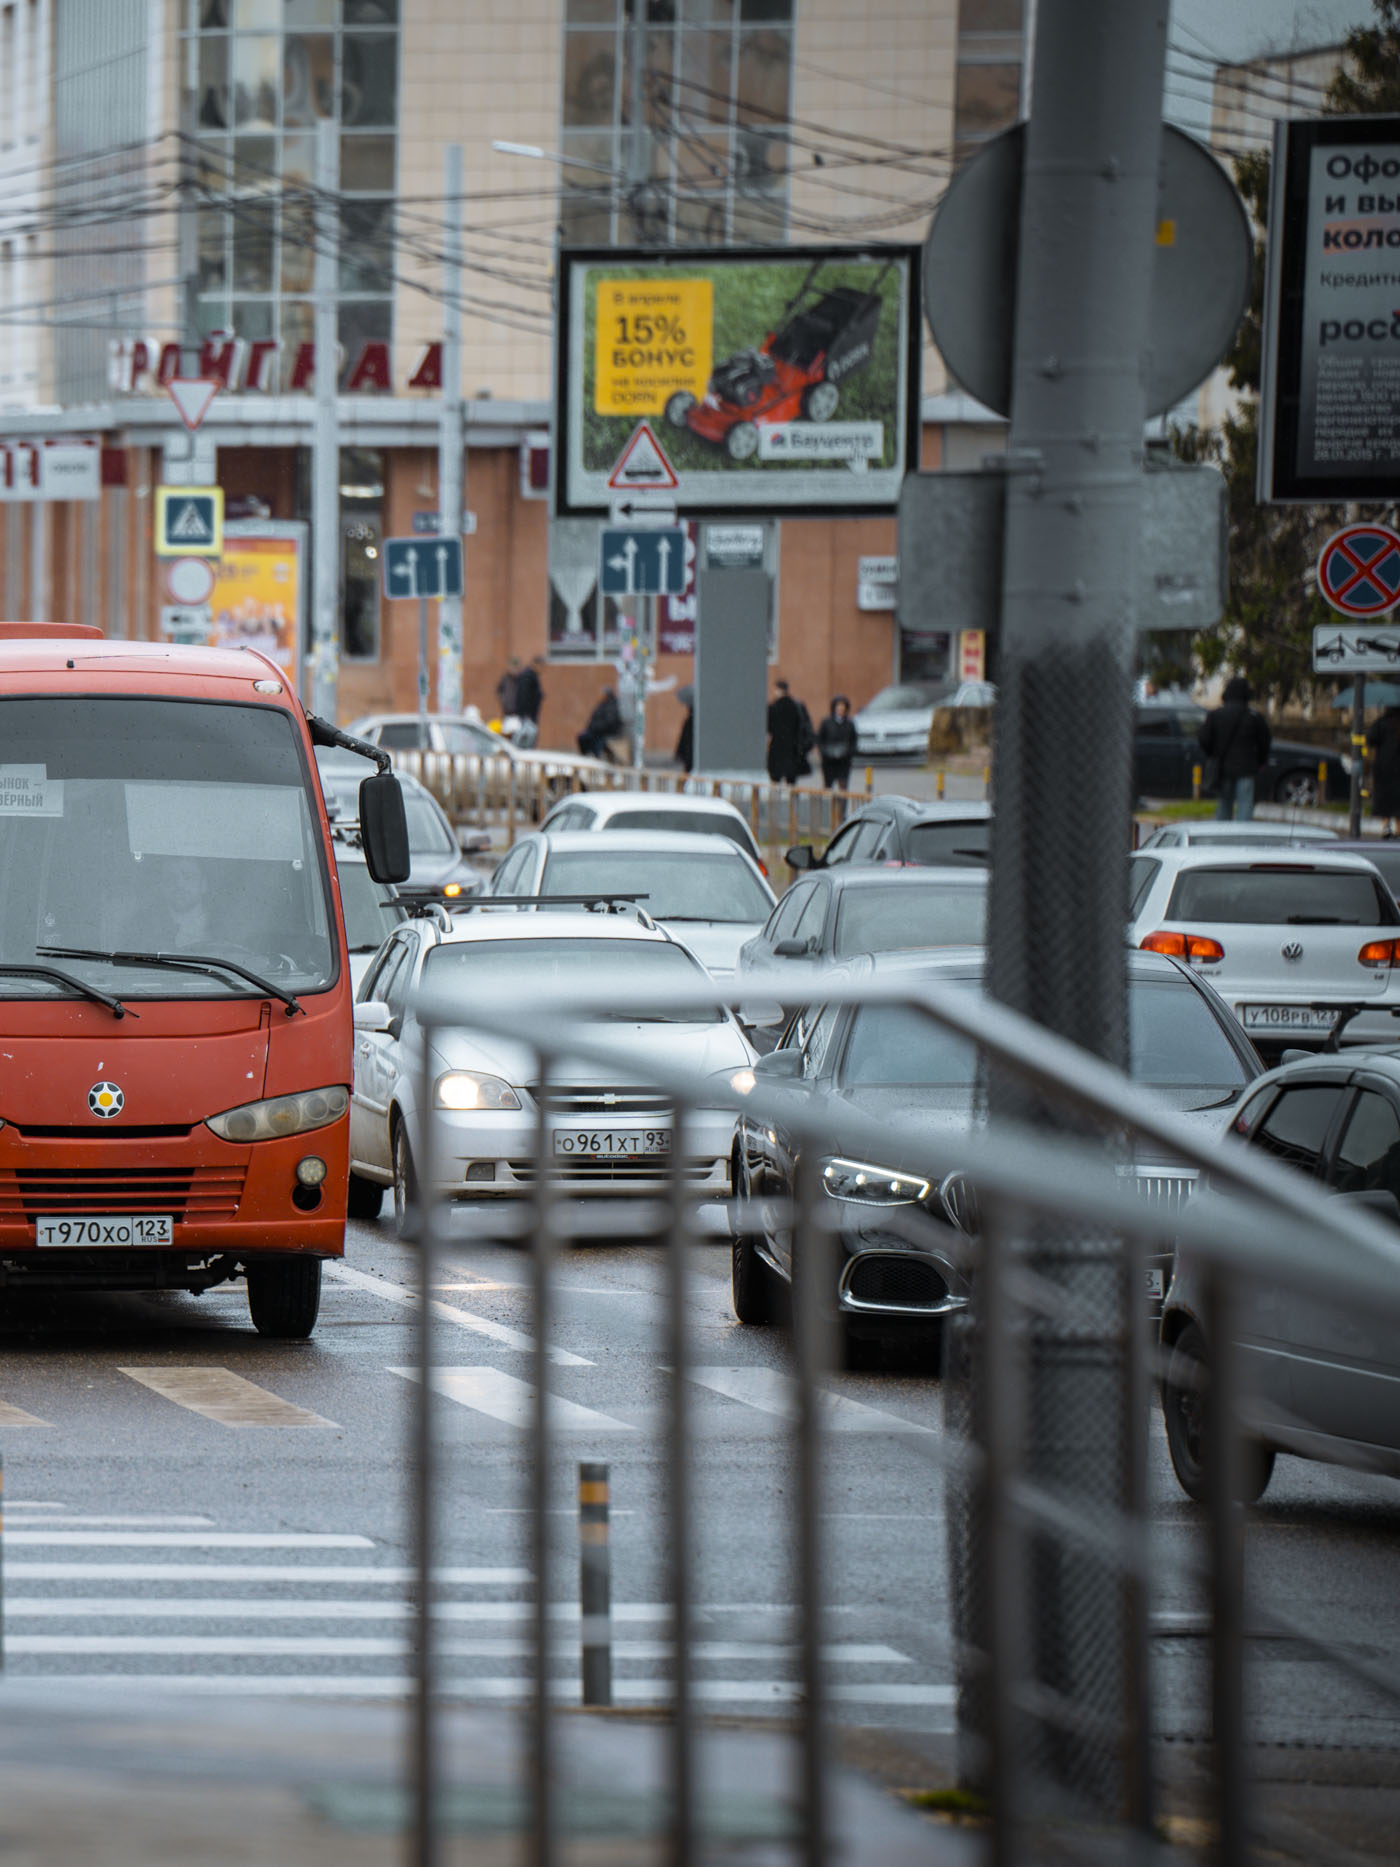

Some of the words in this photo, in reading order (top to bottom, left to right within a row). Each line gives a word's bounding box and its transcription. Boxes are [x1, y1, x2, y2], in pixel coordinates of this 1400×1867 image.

[1325, 196, 1346, 214] и
[615, 315, 686, 344] 15%
[612, 347, 695, 368] БОНУС
[562, 1133, 641, 1152] О961ХТ
[646, 1132, 665, 1147] 93
[44, 1222, 131, 1244] Т970ХО
[135, 1220, 168, 1237] 123
